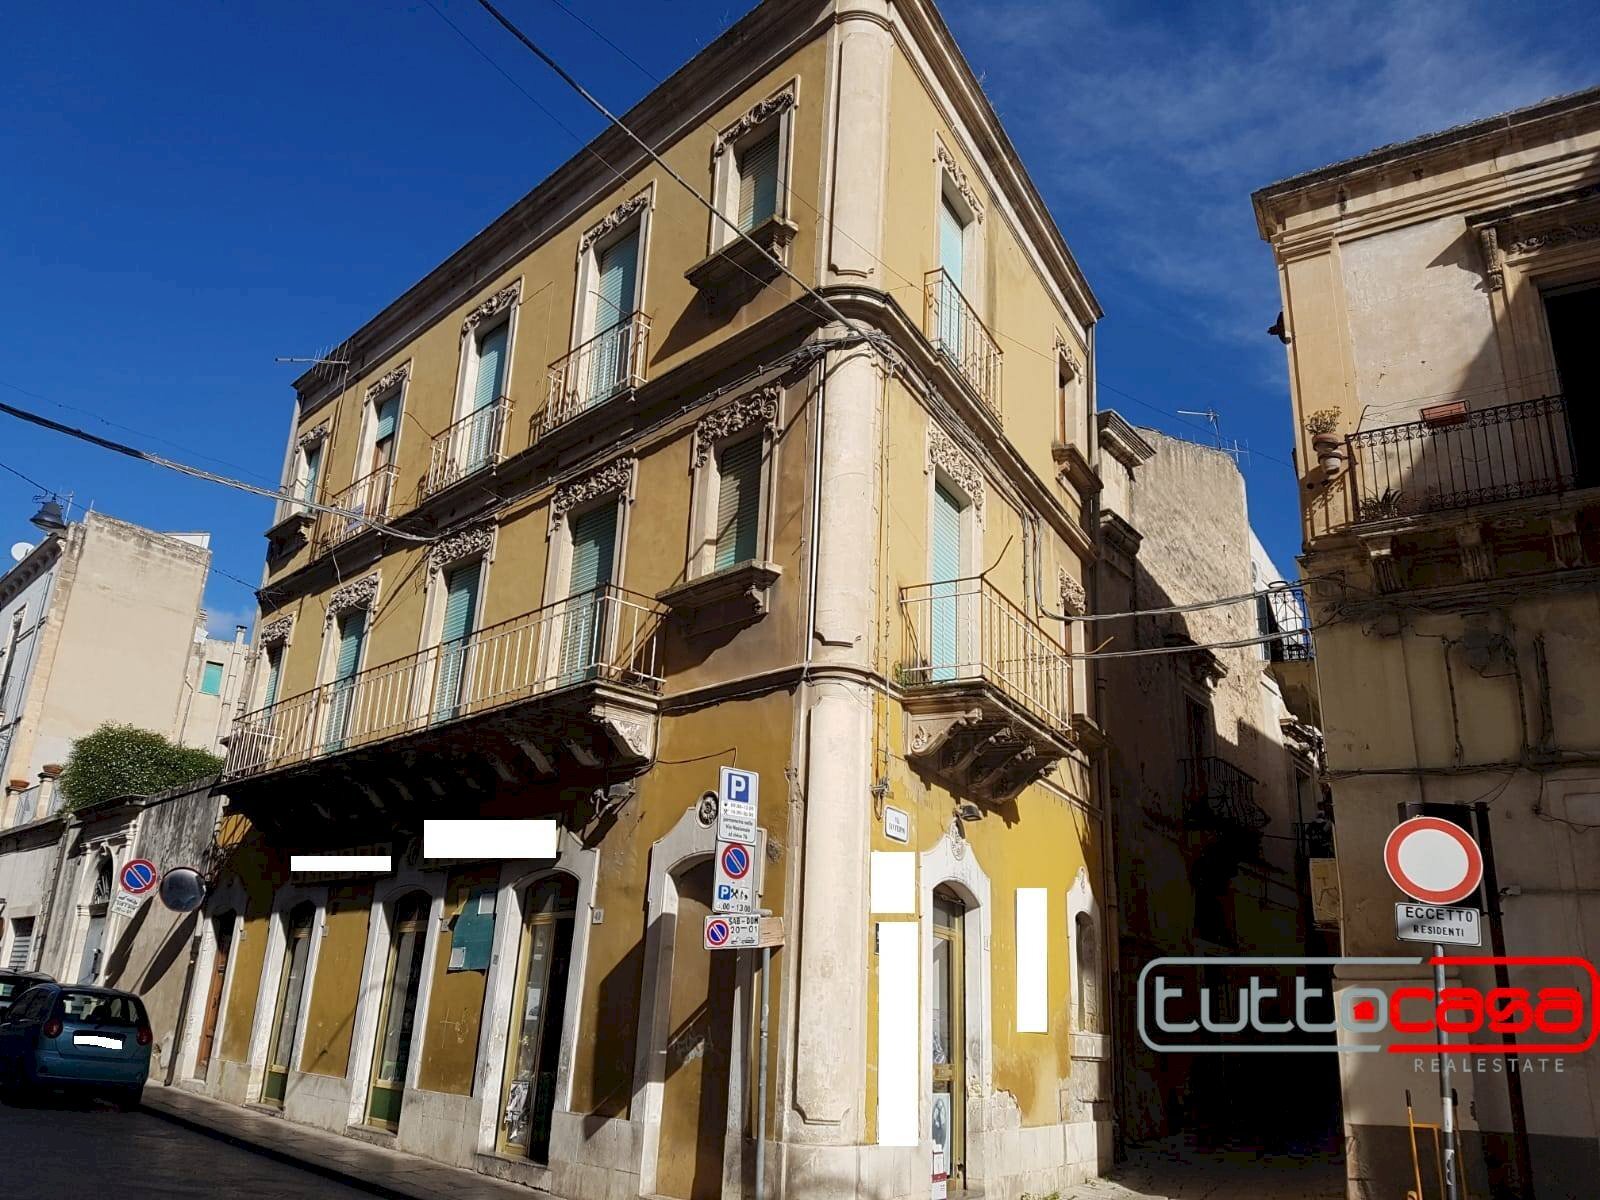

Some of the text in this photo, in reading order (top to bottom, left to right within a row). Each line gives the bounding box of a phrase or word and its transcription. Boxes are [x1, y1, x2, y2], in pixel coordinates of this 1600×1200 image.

[731, 774, 746, 799] P
[720, 886, 729, 899] P
[1405, 906, 1473, 922] ECCETTO
[1413, 924, 1464, 937] RESIDENTI
